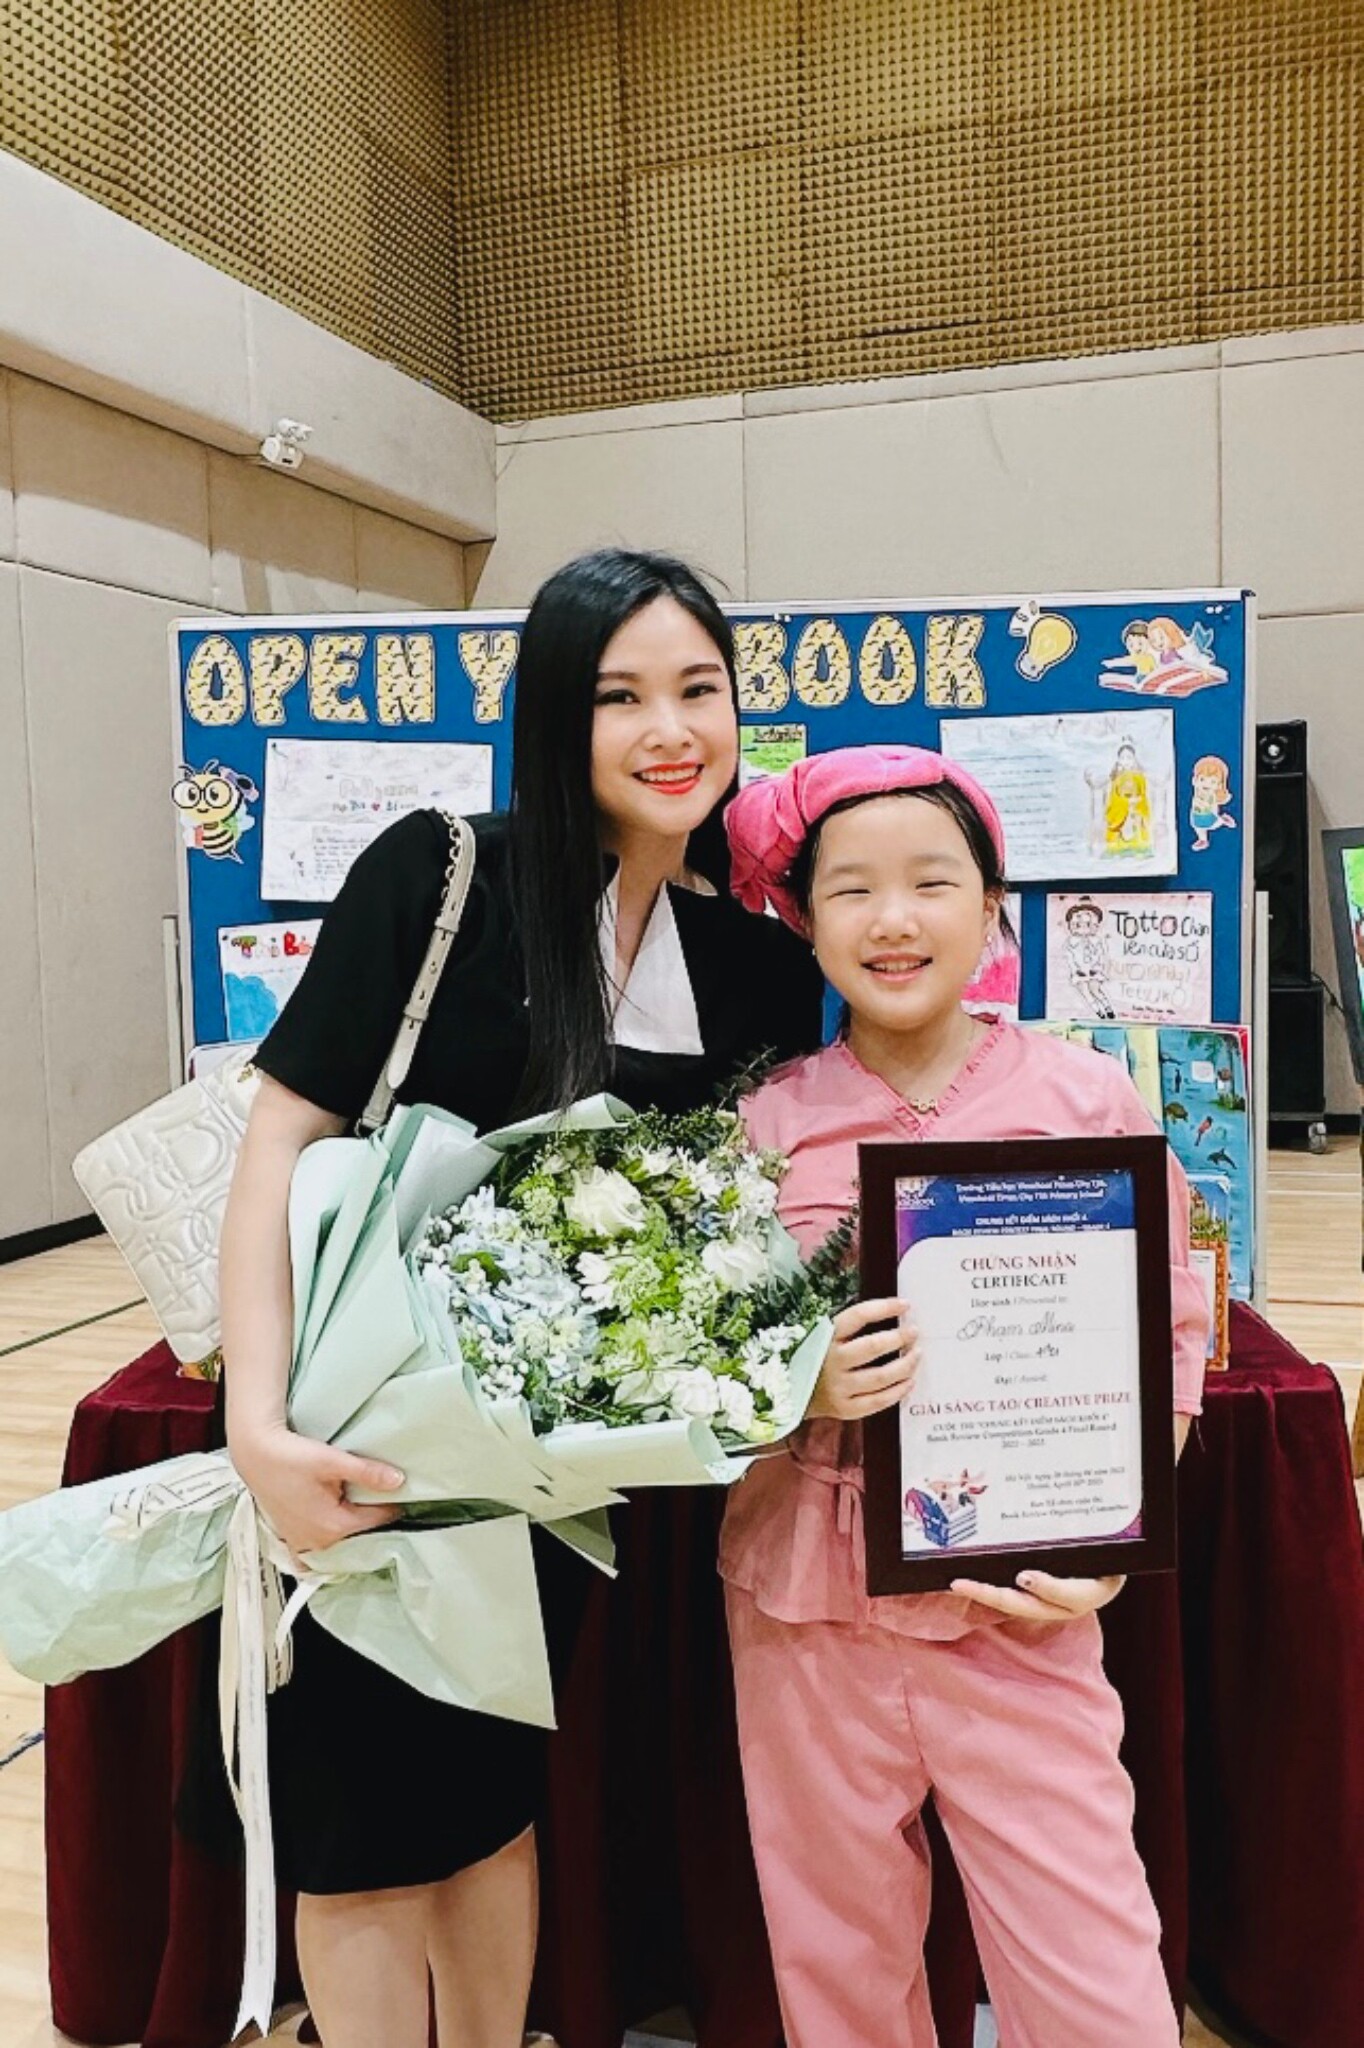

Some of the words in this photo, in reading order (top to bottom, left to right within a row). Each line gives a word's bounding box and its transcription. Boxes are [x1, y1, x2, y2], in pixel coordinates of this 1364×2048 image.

[185, 632, 436, 726] OPEN
[733, 613, 986, 714] BOOK
[1108, 910, 1178, 938] Totto
[971, 1273, 1067, 1289] CERTIFICATE
[1024, 1393, 1091, 1409] CREATIVE
[1094, 1391, 1131, 1405] PRIZE
